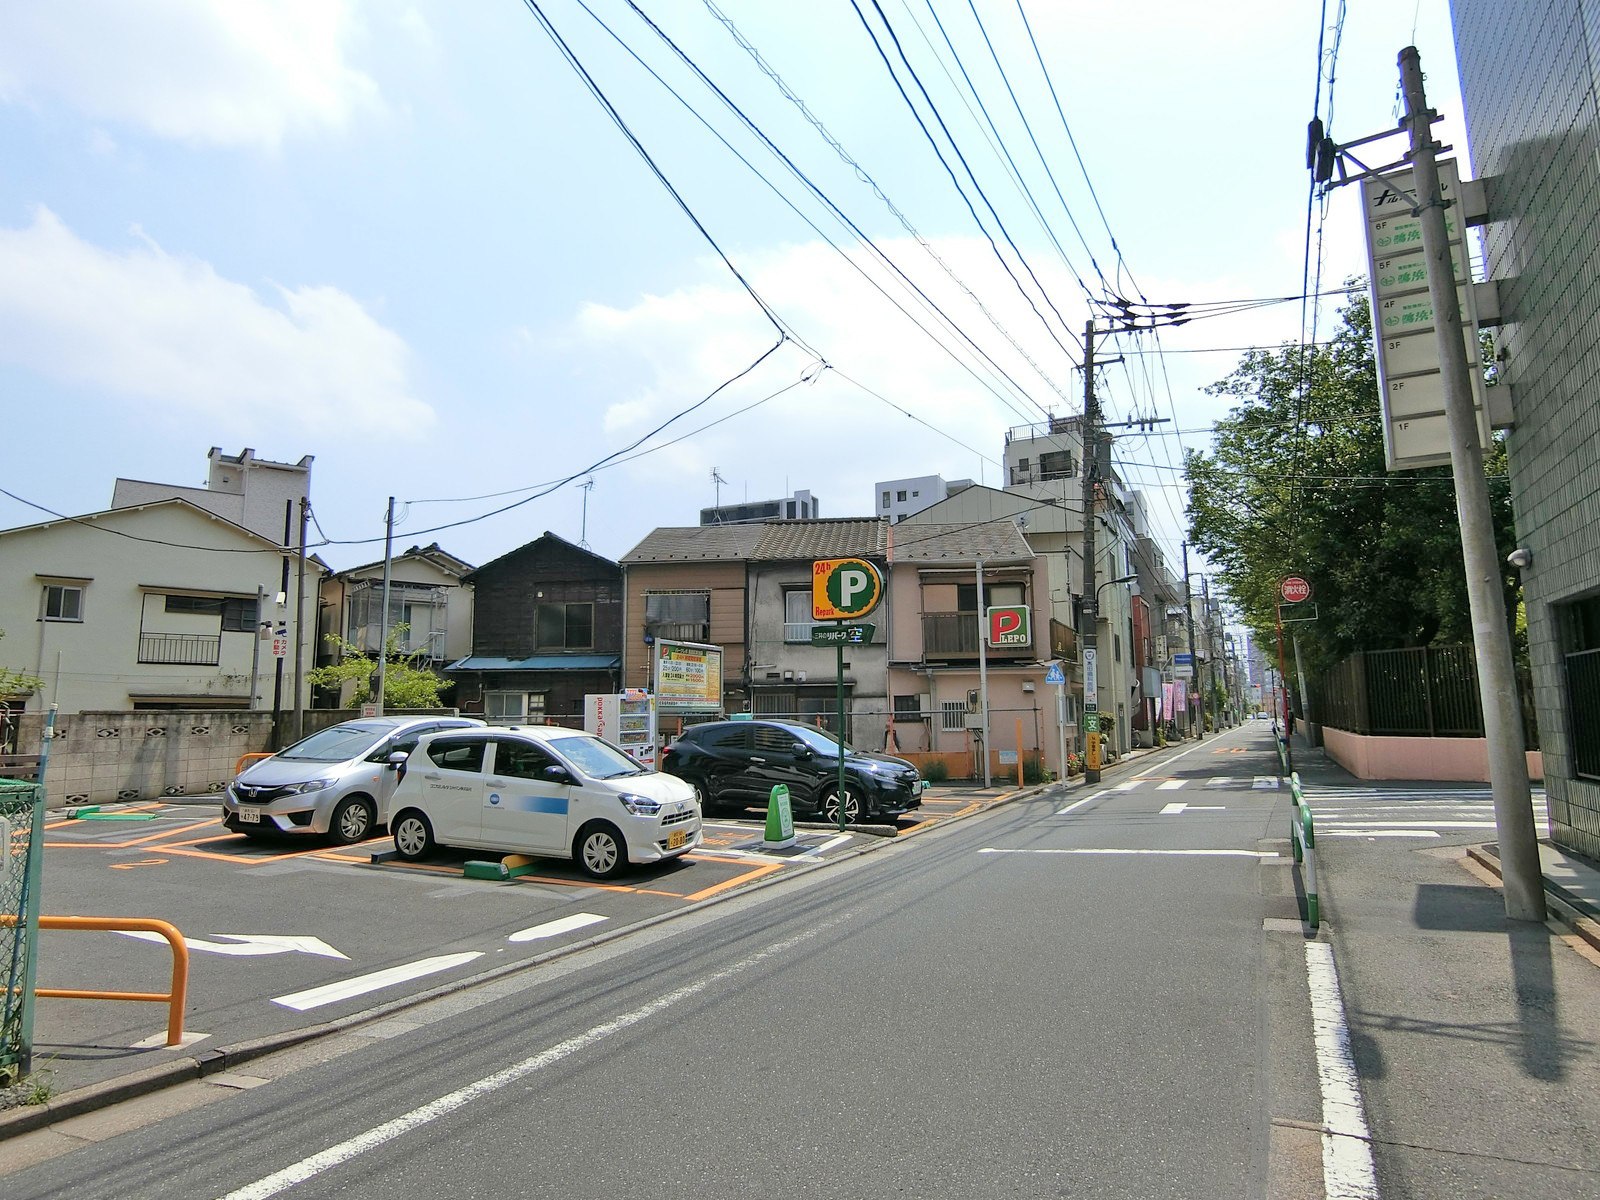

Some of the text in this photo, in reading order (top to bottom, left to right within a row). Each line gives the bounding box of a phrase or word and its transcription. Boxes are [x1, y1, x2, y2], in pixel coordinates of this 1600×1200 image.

[1375, 221, 1387, 230] 6F
[1379, 260, 1391, 269] 5F
[1384, 300, 1395, 308] 4F
[1389, 341, 1401, 350] 3F
[1392, 382, 1404, 391] 2F
[1398, 422, 1409, 431] 1F
[815, 562, 831, 575] 24h
[841, 570, 867, 607] P
[1284, 584, 1307, 595] 消火栓
[815, 606, 834, 617] Repark
[814, 627, 863, 642] 三井のリパーク 空
